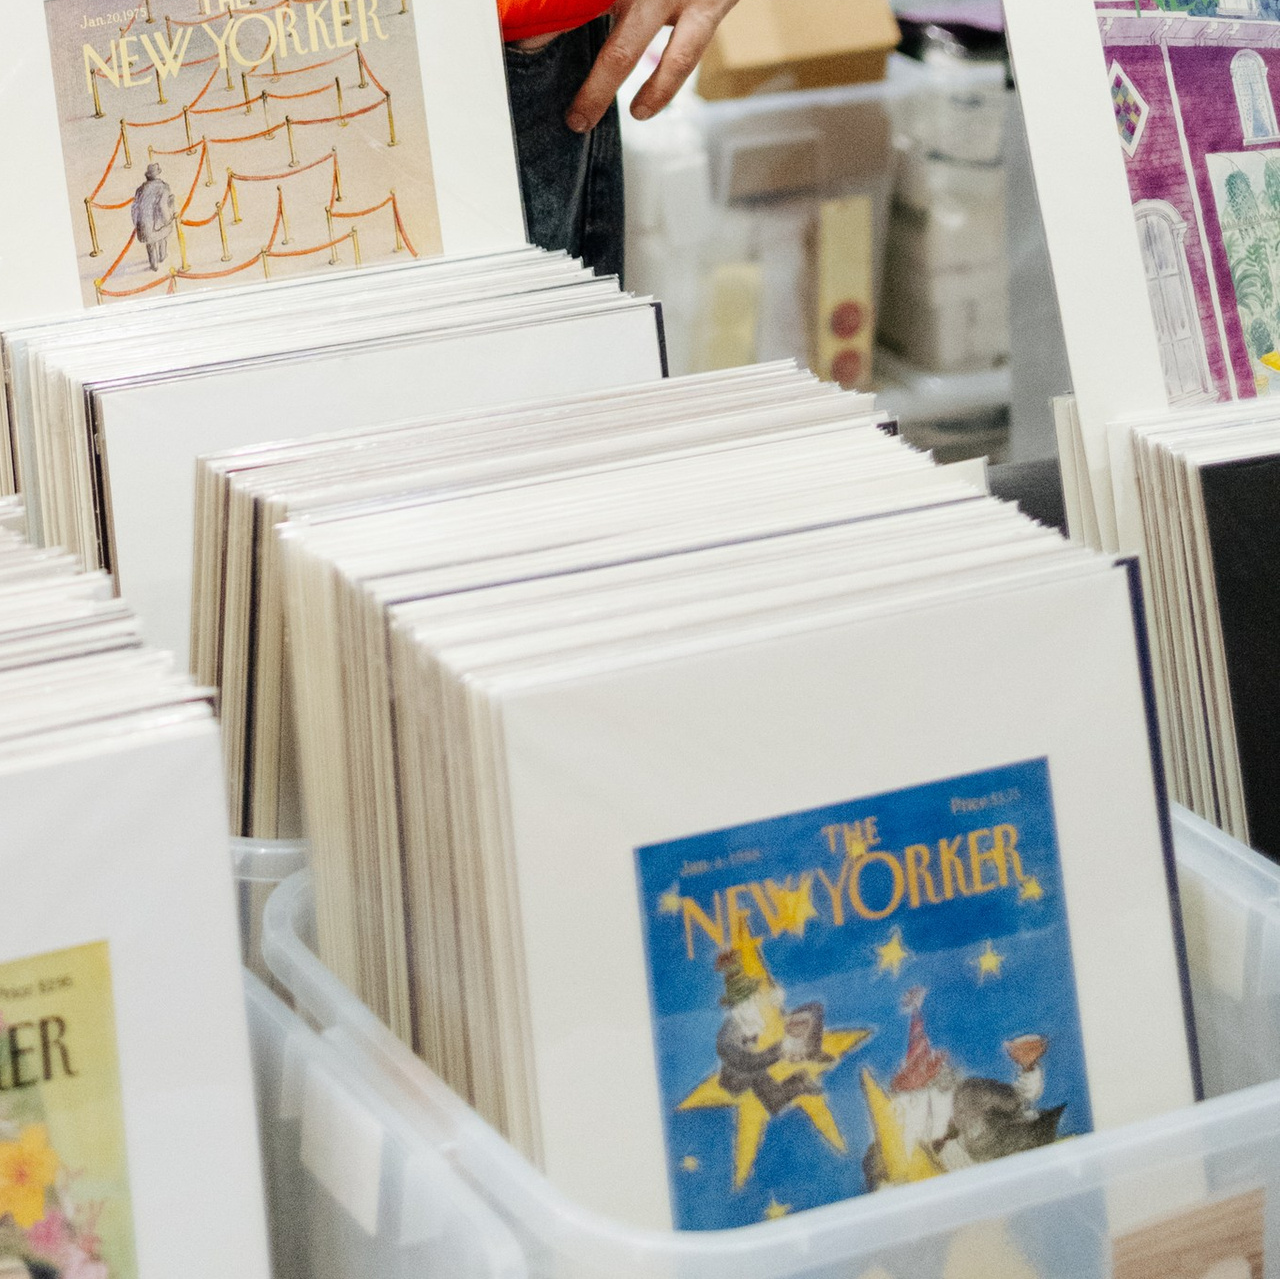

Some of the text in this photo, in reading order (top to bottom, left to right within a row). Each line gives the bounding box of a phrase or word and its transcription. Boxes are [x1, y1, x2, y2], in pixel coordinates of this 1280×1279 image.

[82, 27, 193, 94] NEW
[822, 816, 881, 853] THE
[682, 823, 1028, 960] NEW YORKER
